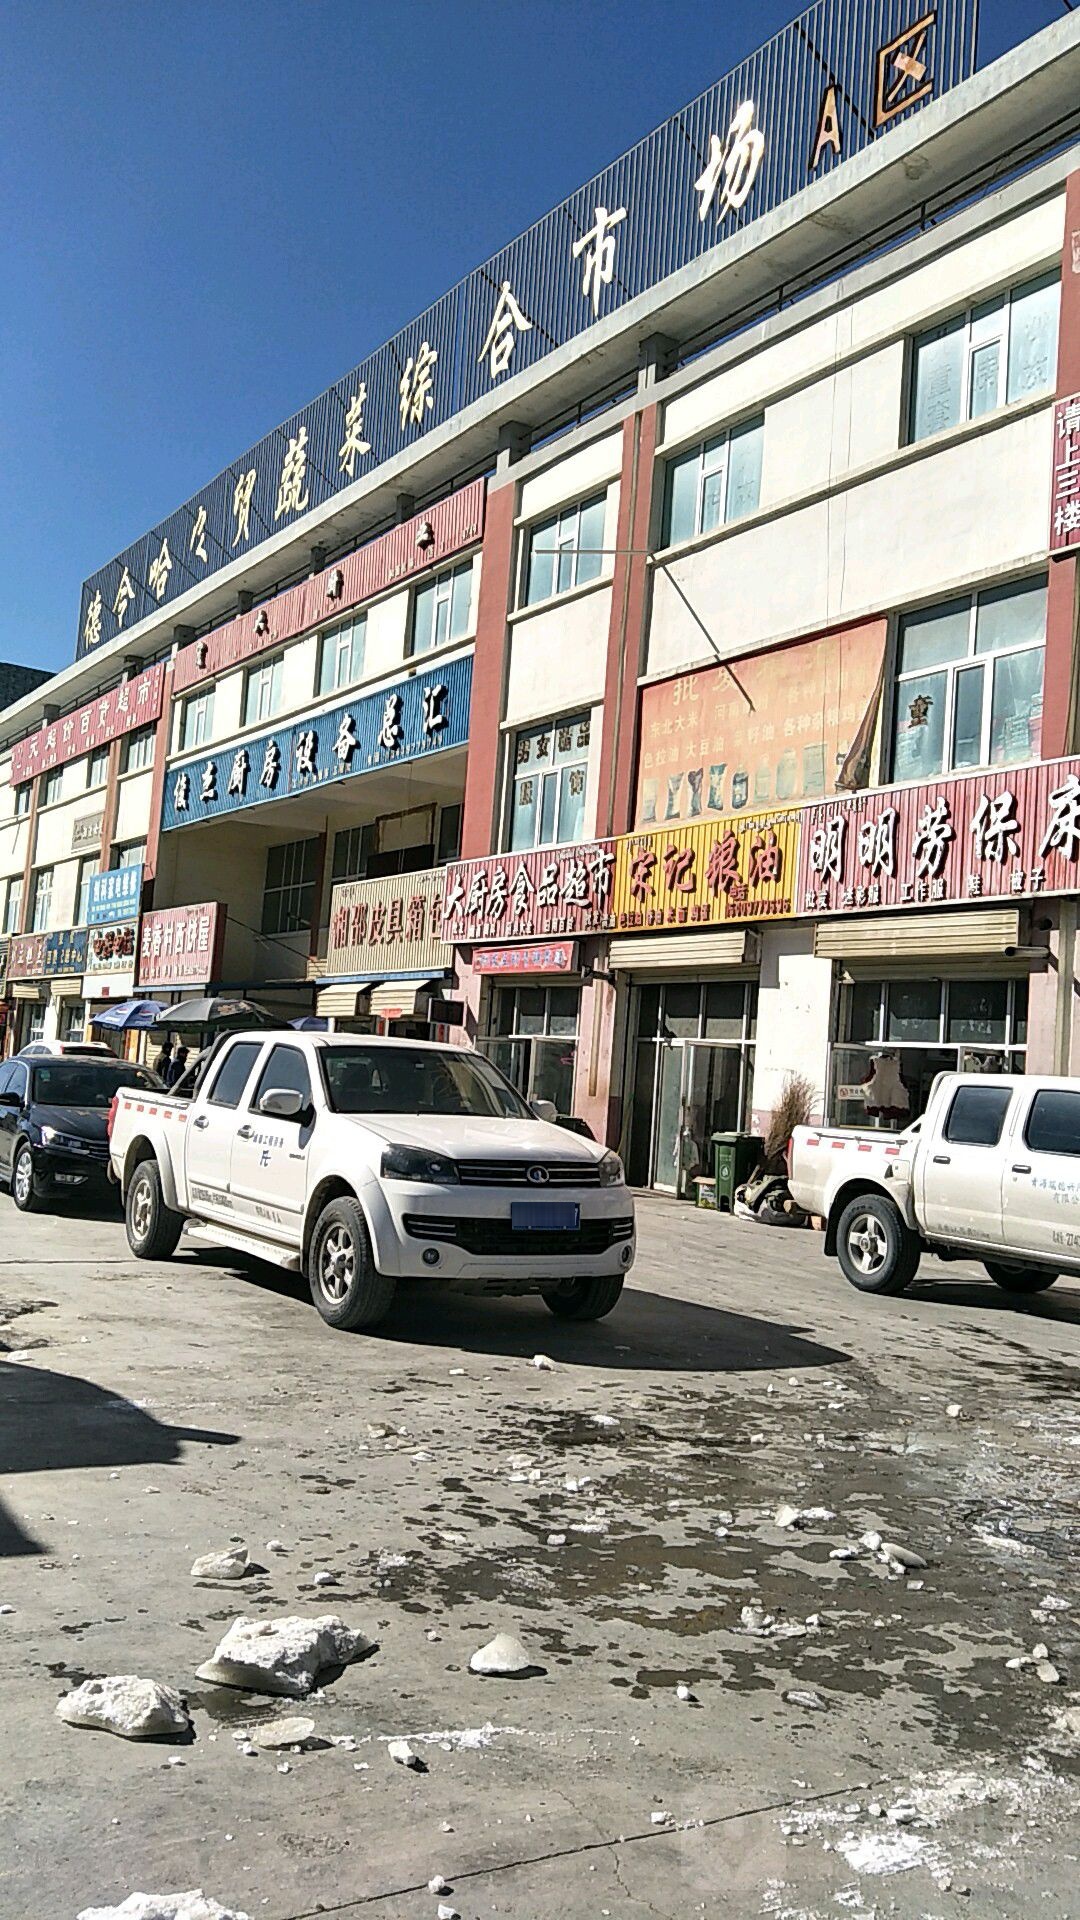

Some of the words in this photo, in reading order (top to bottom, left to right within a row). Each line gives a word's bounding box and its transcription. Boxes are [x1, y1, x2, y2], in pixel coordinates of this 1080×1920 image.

[1054, 403, 1080, 536] 请上三楼
[444, 849, 616, 919] 大厨房食品超市
[630, 830, 783, 902] 宋记粮油
[729, 884, 748, 900] 电话
[805, 888, 830, 911] 批发
[843, 883, 881, 907] 迷彩服
[900, 878, 947, 902] 工作服
[1010, 867, 1046, 892] 被子
[142, 916, 210, 957] 麦香村西饼屋
